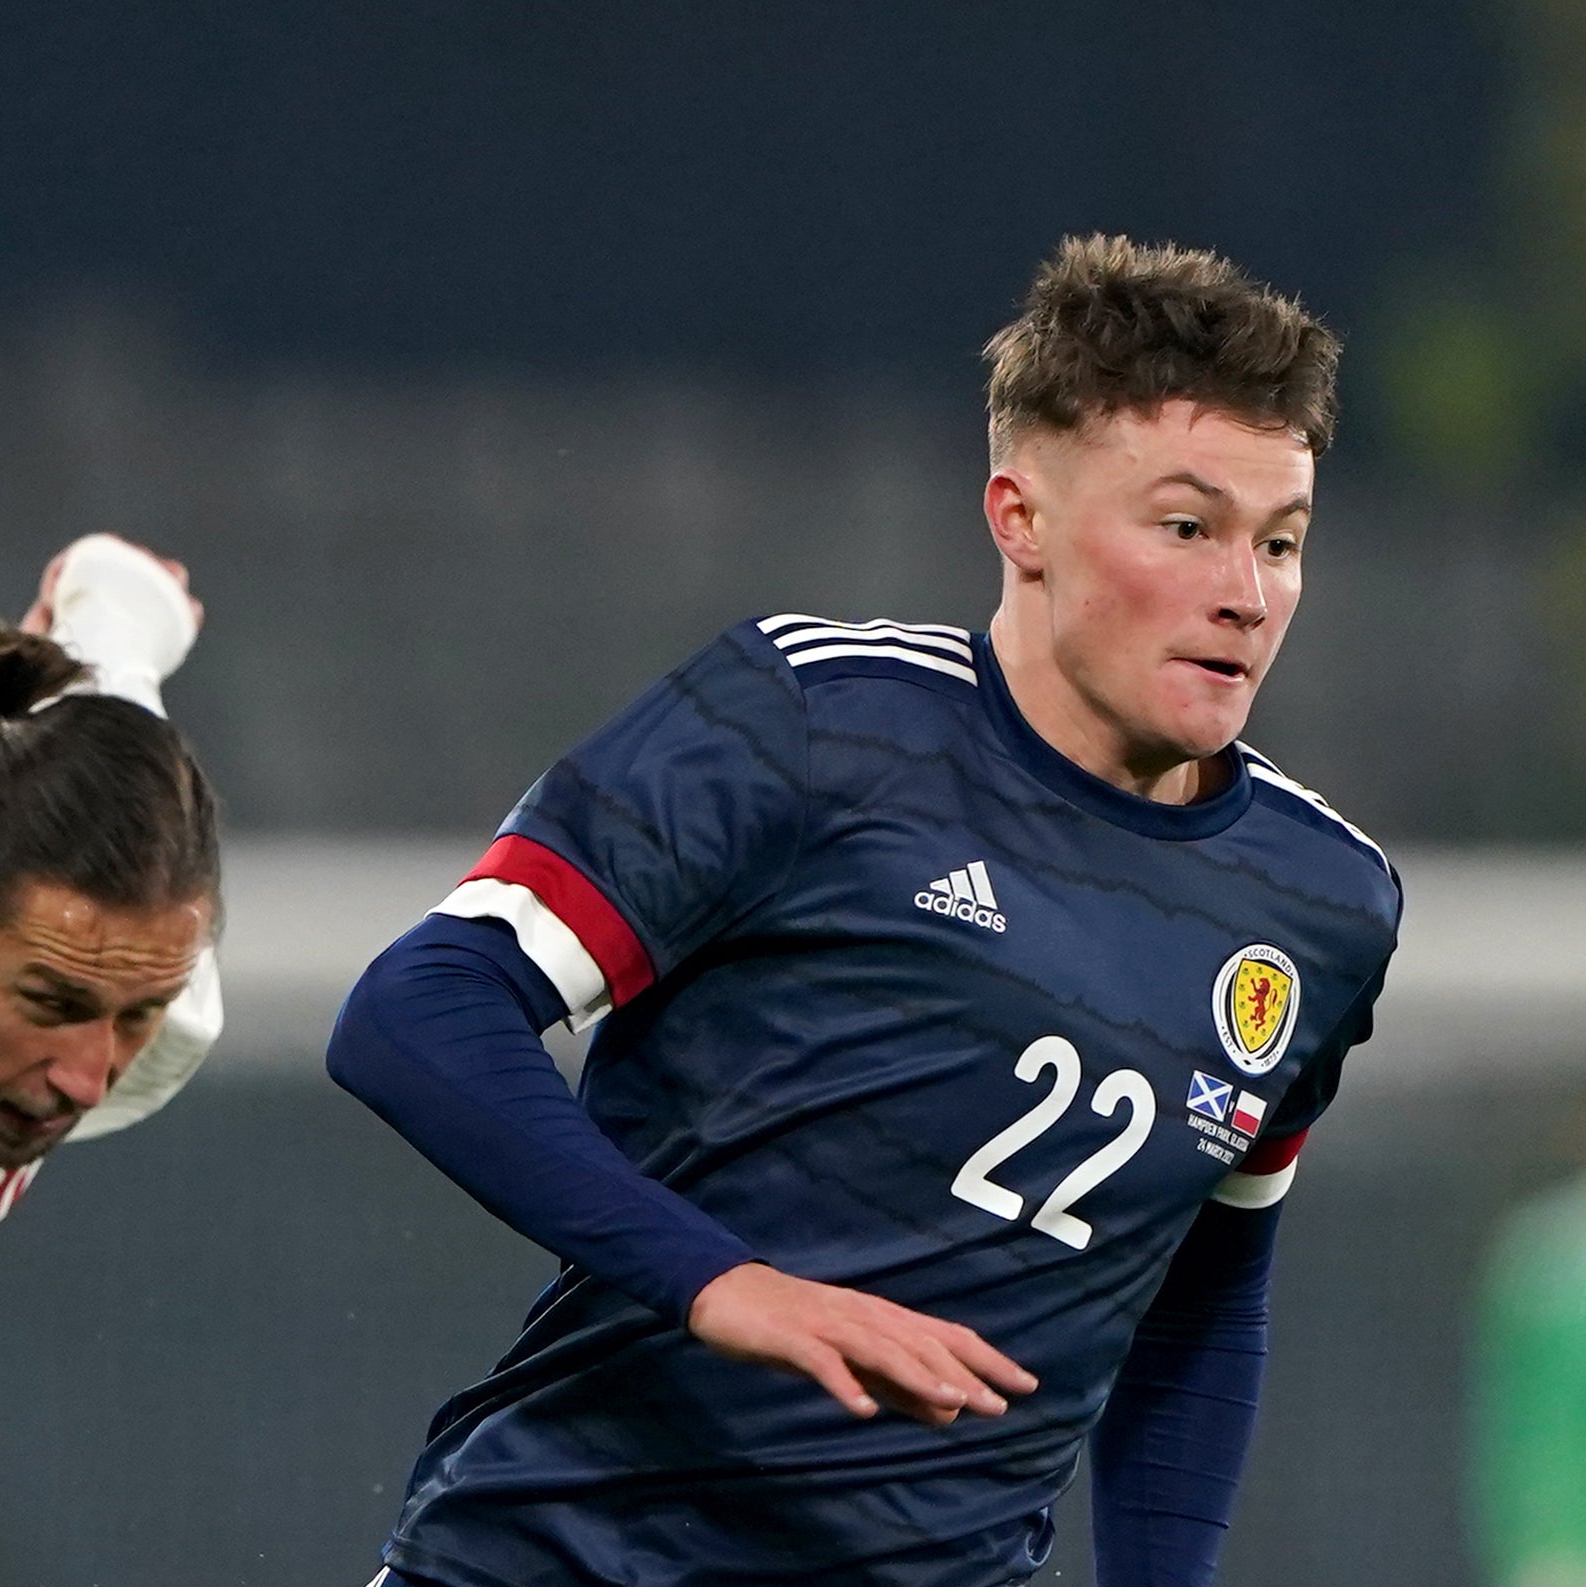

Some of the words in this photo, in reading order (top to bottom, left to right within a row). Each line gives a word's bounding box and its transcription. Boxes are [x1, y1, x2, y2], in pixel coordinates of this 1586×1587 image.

[914, 889, 1007, 934] adidas
[1248, 948, 1292, 975] SCOTLAND
[951, 1035, 1156, 1250] 22
